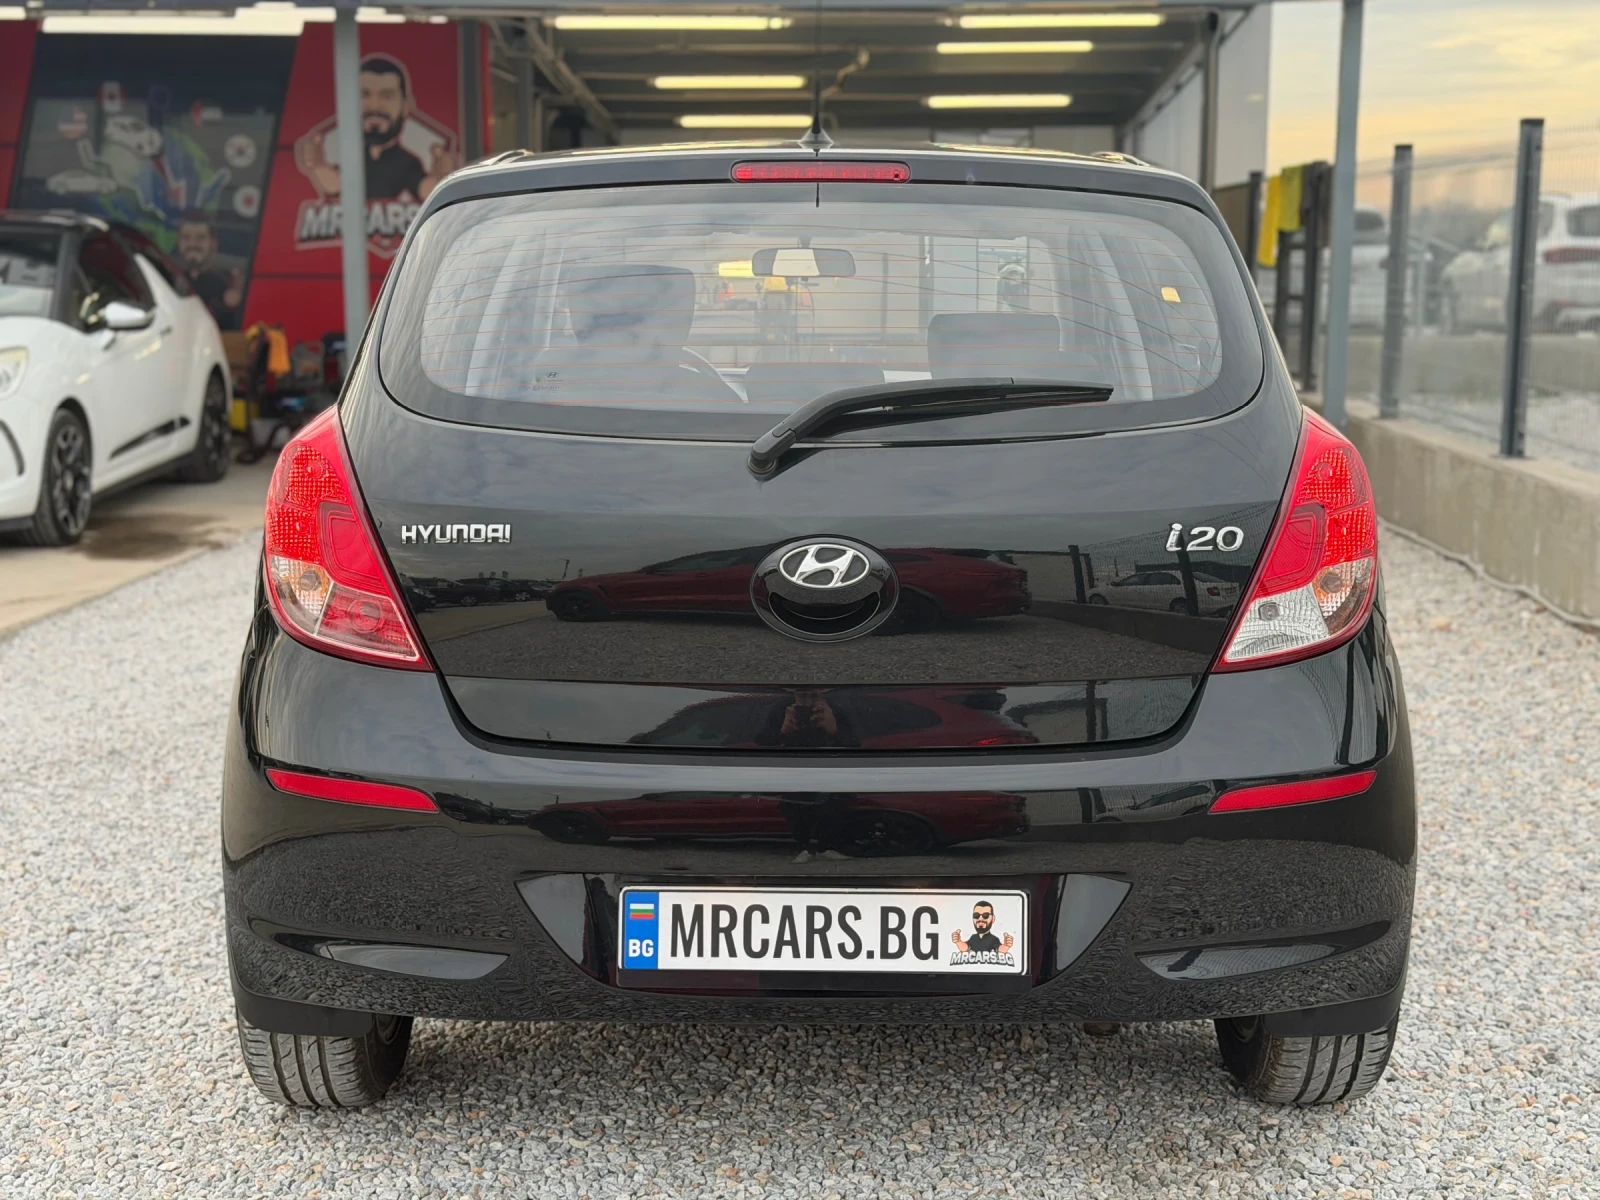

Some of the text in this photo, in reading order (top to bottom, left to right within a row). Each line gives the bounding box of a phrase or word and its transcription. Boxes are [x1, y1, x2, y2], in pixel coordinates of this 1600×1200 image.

[299, 200, 421, 240] MRARS
[401, 523, 511, 544] HYUNDAI
[1166, 523, 1244, 552] i20
[670, 903, 939, 961] MRCARS.BG
[628, 939, 654, 958] BG
[950, 950, 1015, 967] MRCARS.BG
